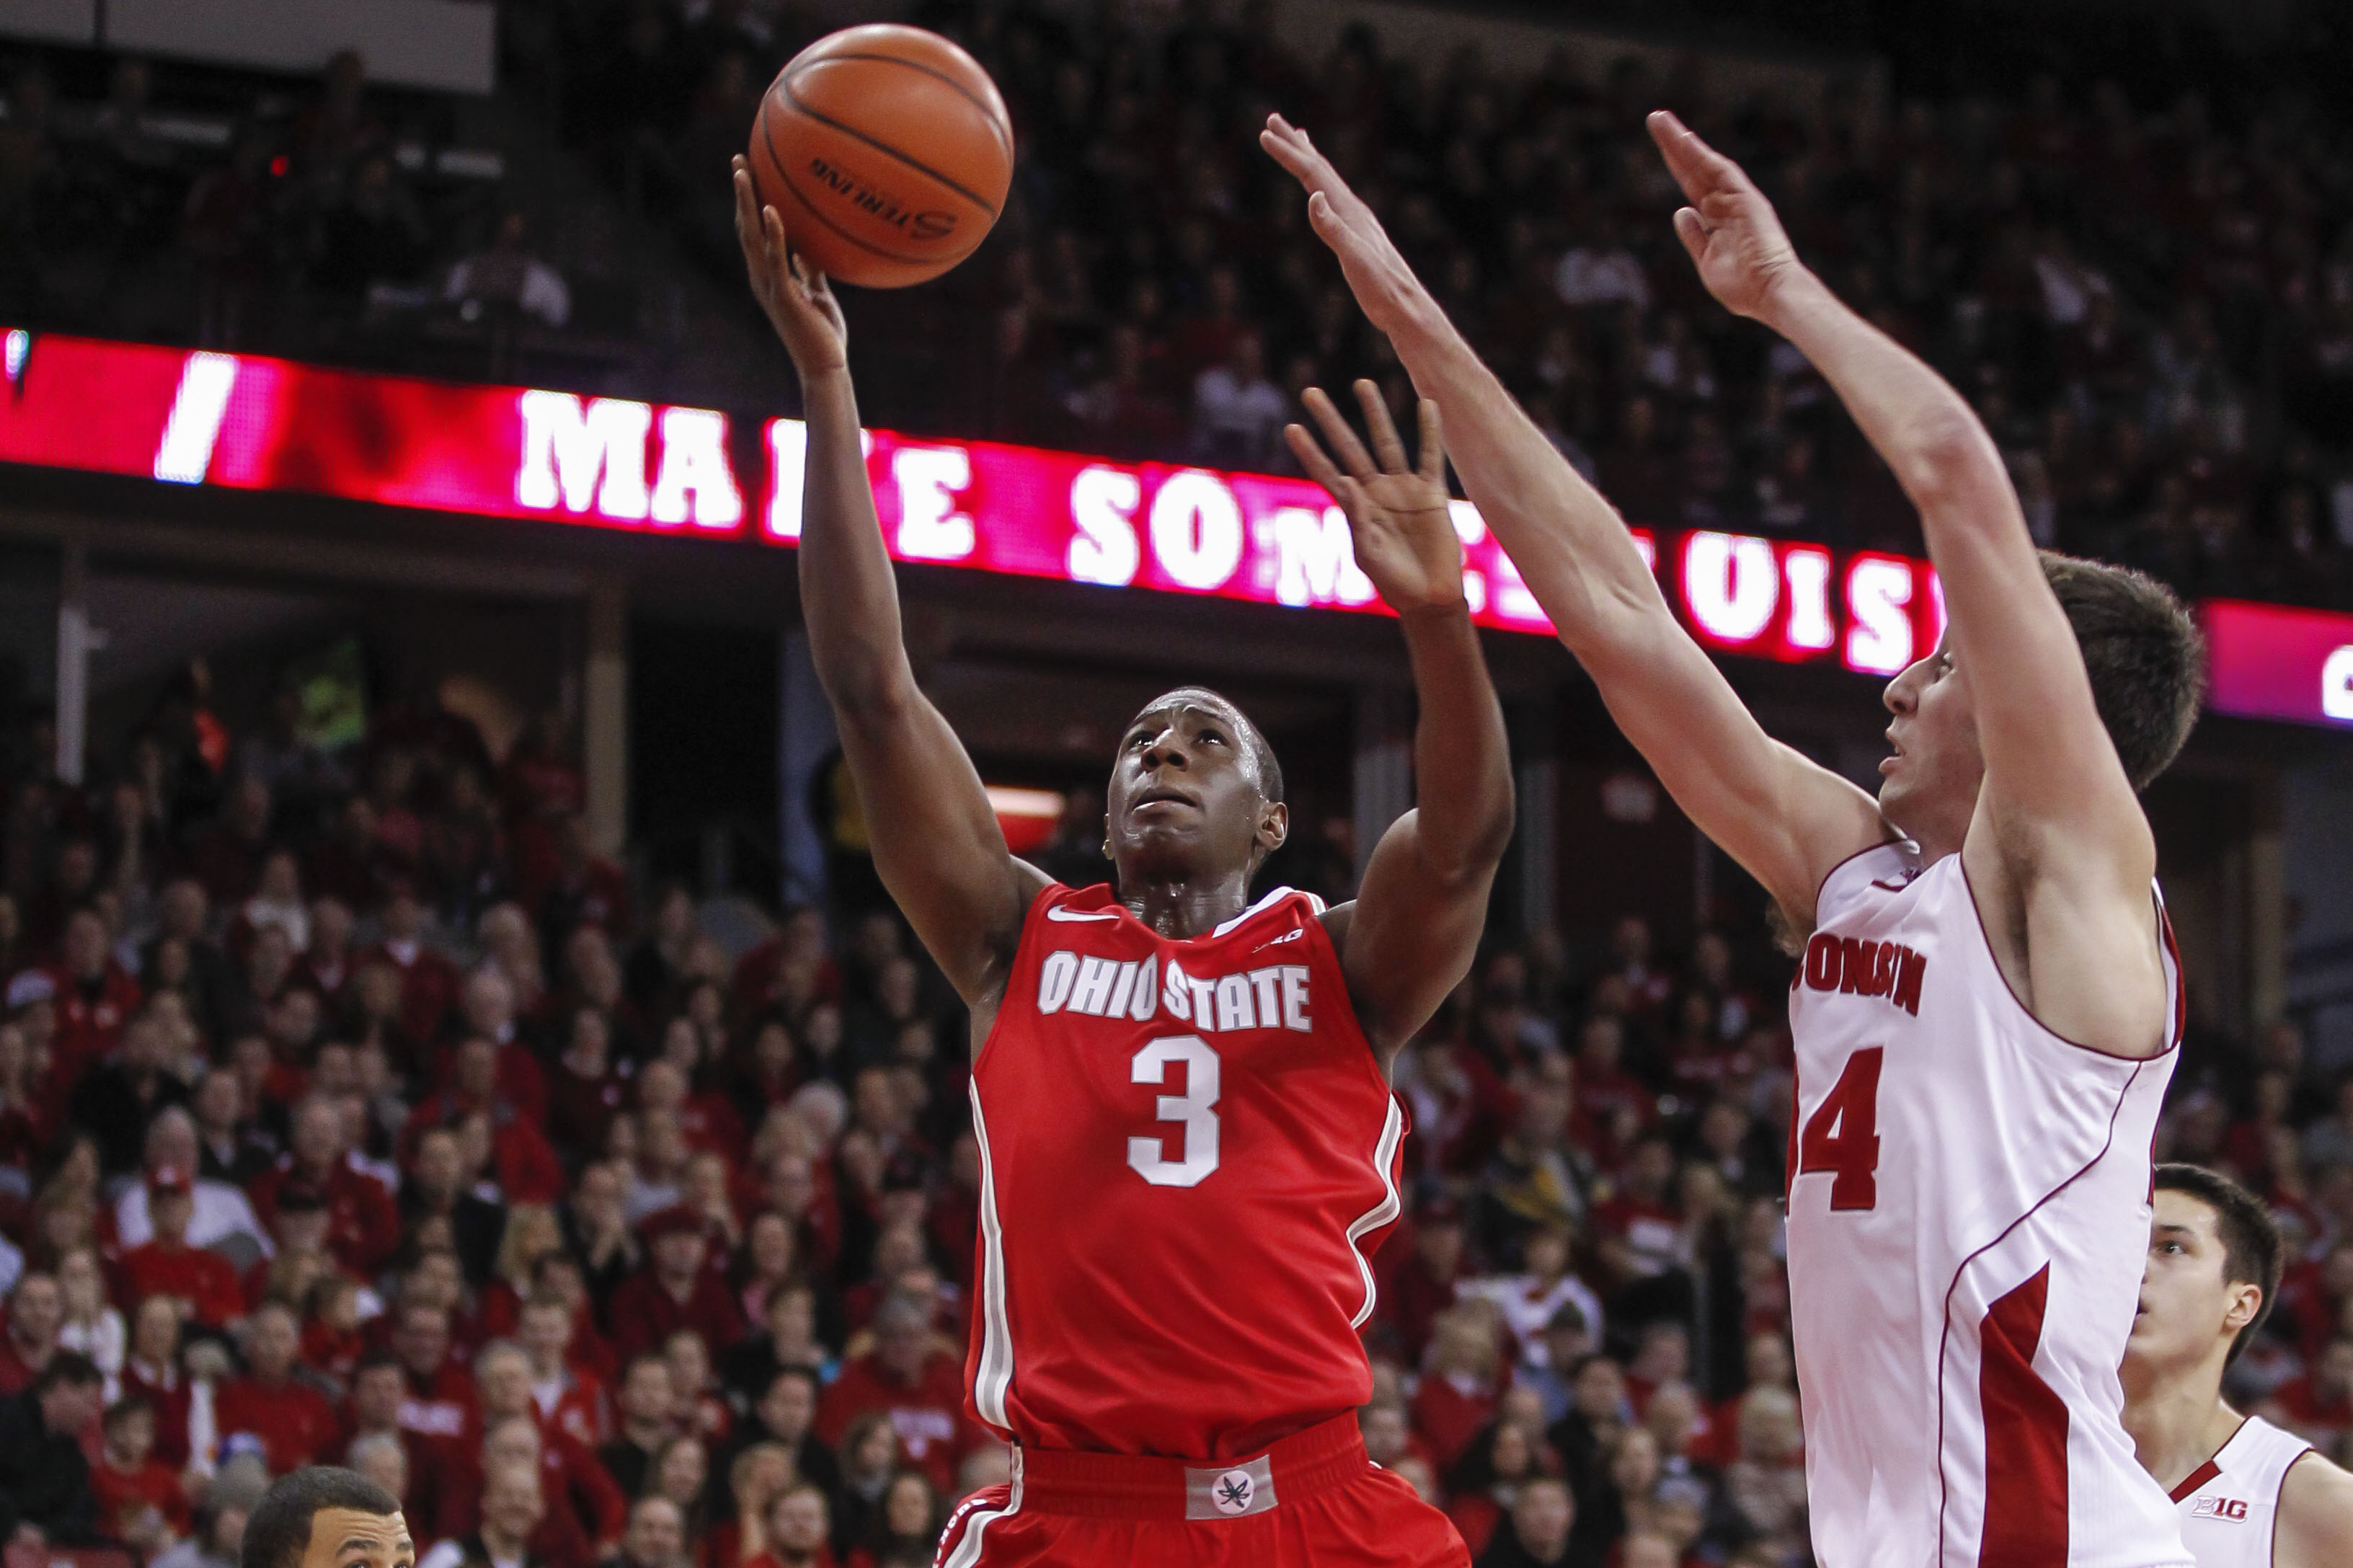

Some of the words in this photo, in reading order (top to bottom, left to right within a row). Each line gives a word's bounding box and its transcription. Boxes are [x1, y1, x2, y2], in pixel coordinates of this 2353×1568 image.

[1067, 463, 1486, 614] SOM
[1037, 949, 1158, 1022] OHIO
[1162, 957, 1313, 1033] STATE
[1792, 933, 1928, 1018] ONSIN
[1126, 1034, 1221, 1188] 3
[1785, 1045, 1884, 1216] 4
